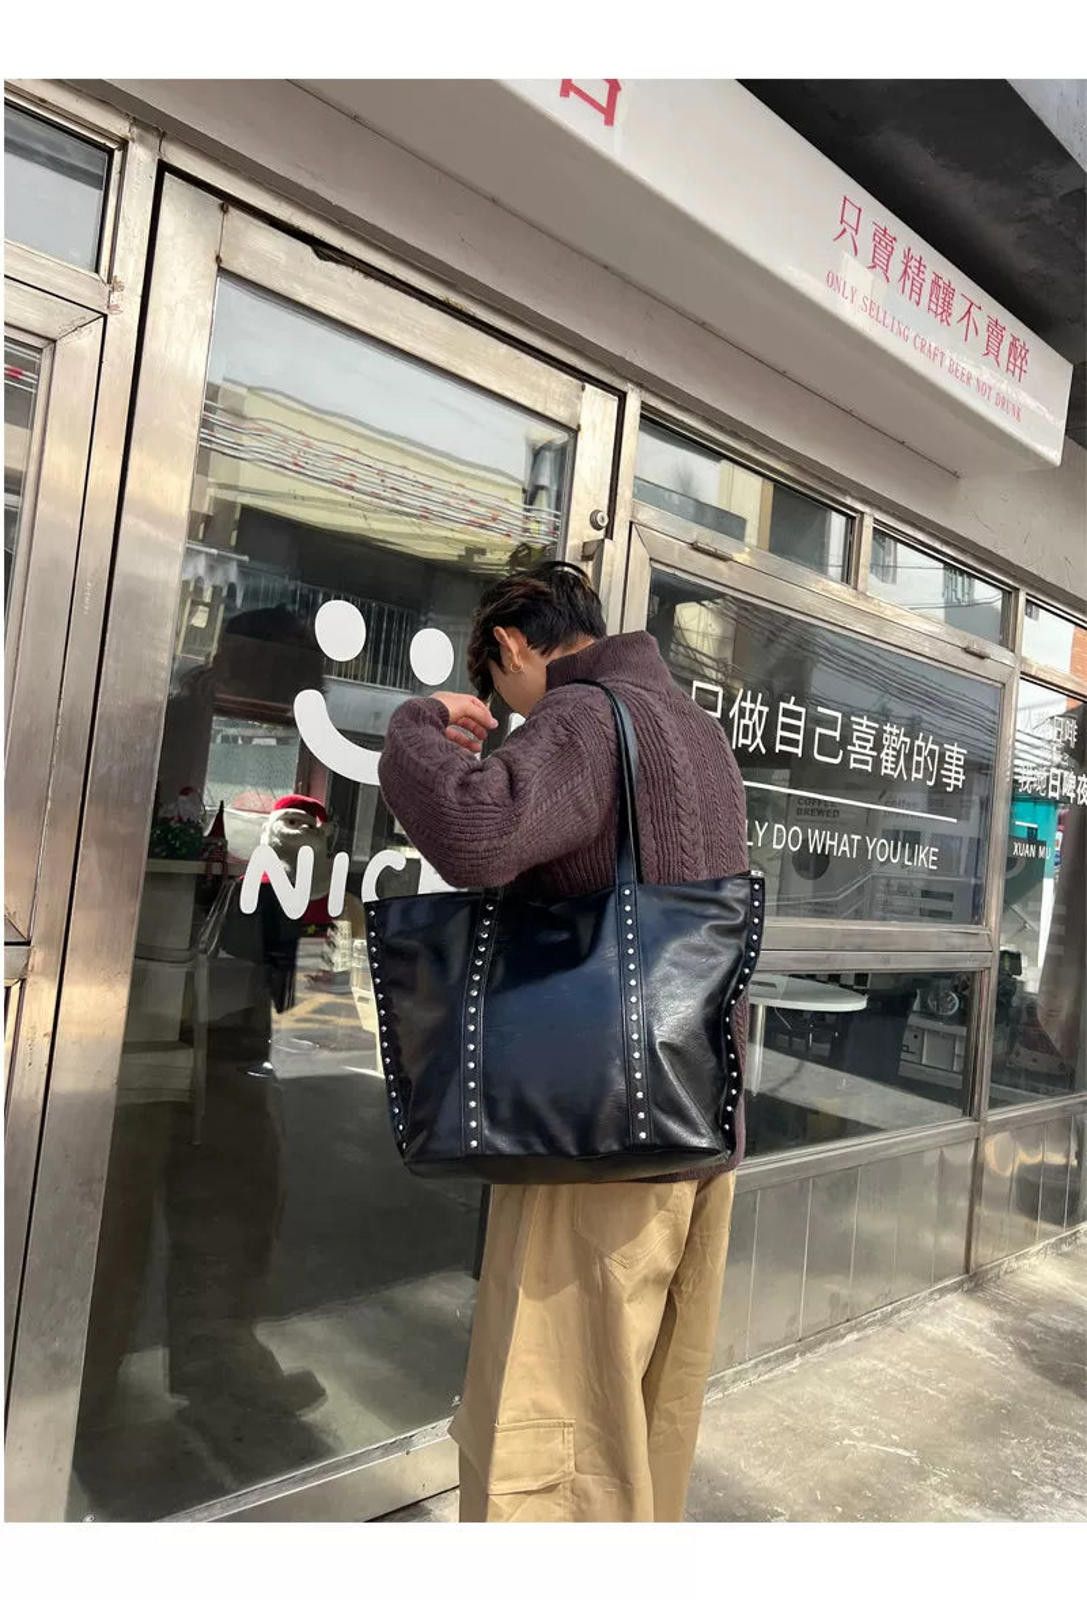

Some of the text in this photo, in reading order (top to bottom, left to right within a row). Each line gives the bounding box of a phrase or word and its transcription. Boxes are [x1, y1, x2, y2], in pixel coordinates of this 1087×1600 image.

[833, 195, 1030, 383] 只賣精釀不賣醉
[825, 270, 857, 304] ONLY
[861, 295, 911, 343] SELLING
[913, 333, 946, 368] CRAFT
[948, 358, 974, 386] BEER
[976, 377, 994, 401] NOT
[773, 823, 803, 851] DO
[807, 827, 862, 860] WHAT
[865, 836, 902, 863] YOU
[904, 843, 940, 870] LIKE
[1013, 842, 1036, 858] XUAN
